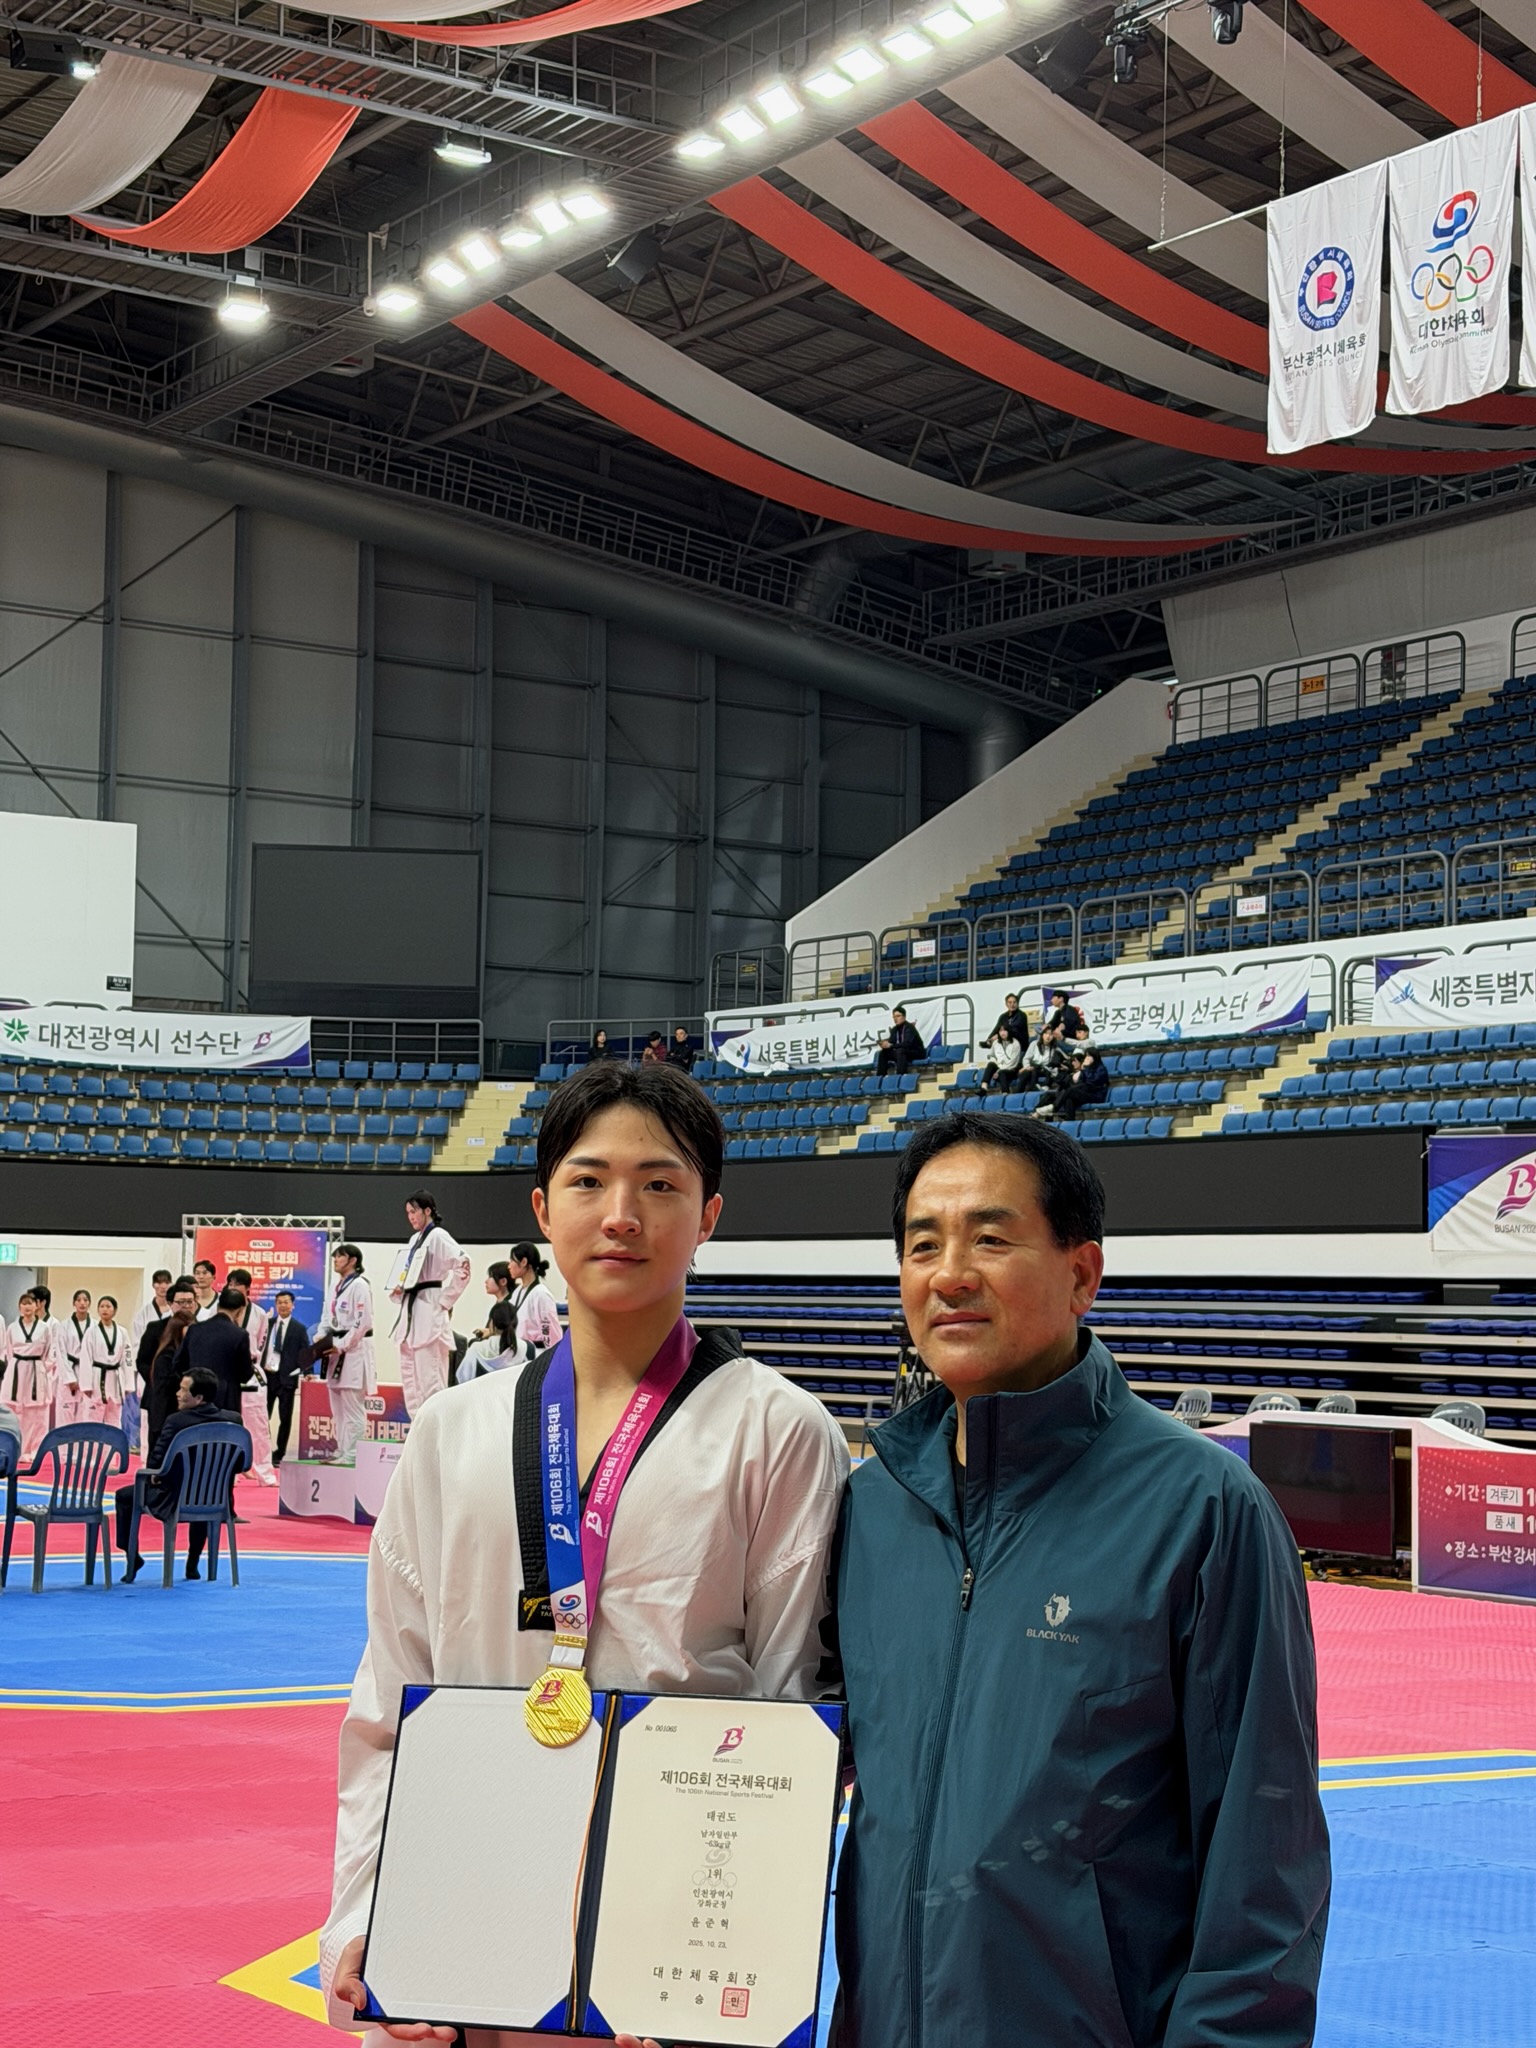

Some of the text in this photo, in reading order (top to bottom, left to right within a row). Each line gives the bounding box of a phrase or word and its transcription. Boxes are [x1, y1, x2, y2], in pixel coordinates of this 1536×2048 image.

[1092, 991, 1249, 1033] 광주광역시 선수단
[38, 1022, 242, 1055] 대전광역시 선수단
[758, 1034, 837, 1064] 서울특별시
[1494, 1224, 1521, 1233] BUSAN
[547, 1403, 563, 1516] 제106회 전국체육대회
[593, 1393, 653, 1505] 제106회 전국체육대회
[311, 1479, 320, 1502] 2
[1490, 1488, 1519, 1503] 겨루기
[660, 1769, 793, 1792] 제106회 전국체육대회
[705, 1789, 729, 1797] National
[730, 1790, 750, 1799] Sports
[751, 1791, 775, 1799] Festival
[706, 1811, 737, 1822] 태권도
[708, 1868, 722, 1880] 1위
